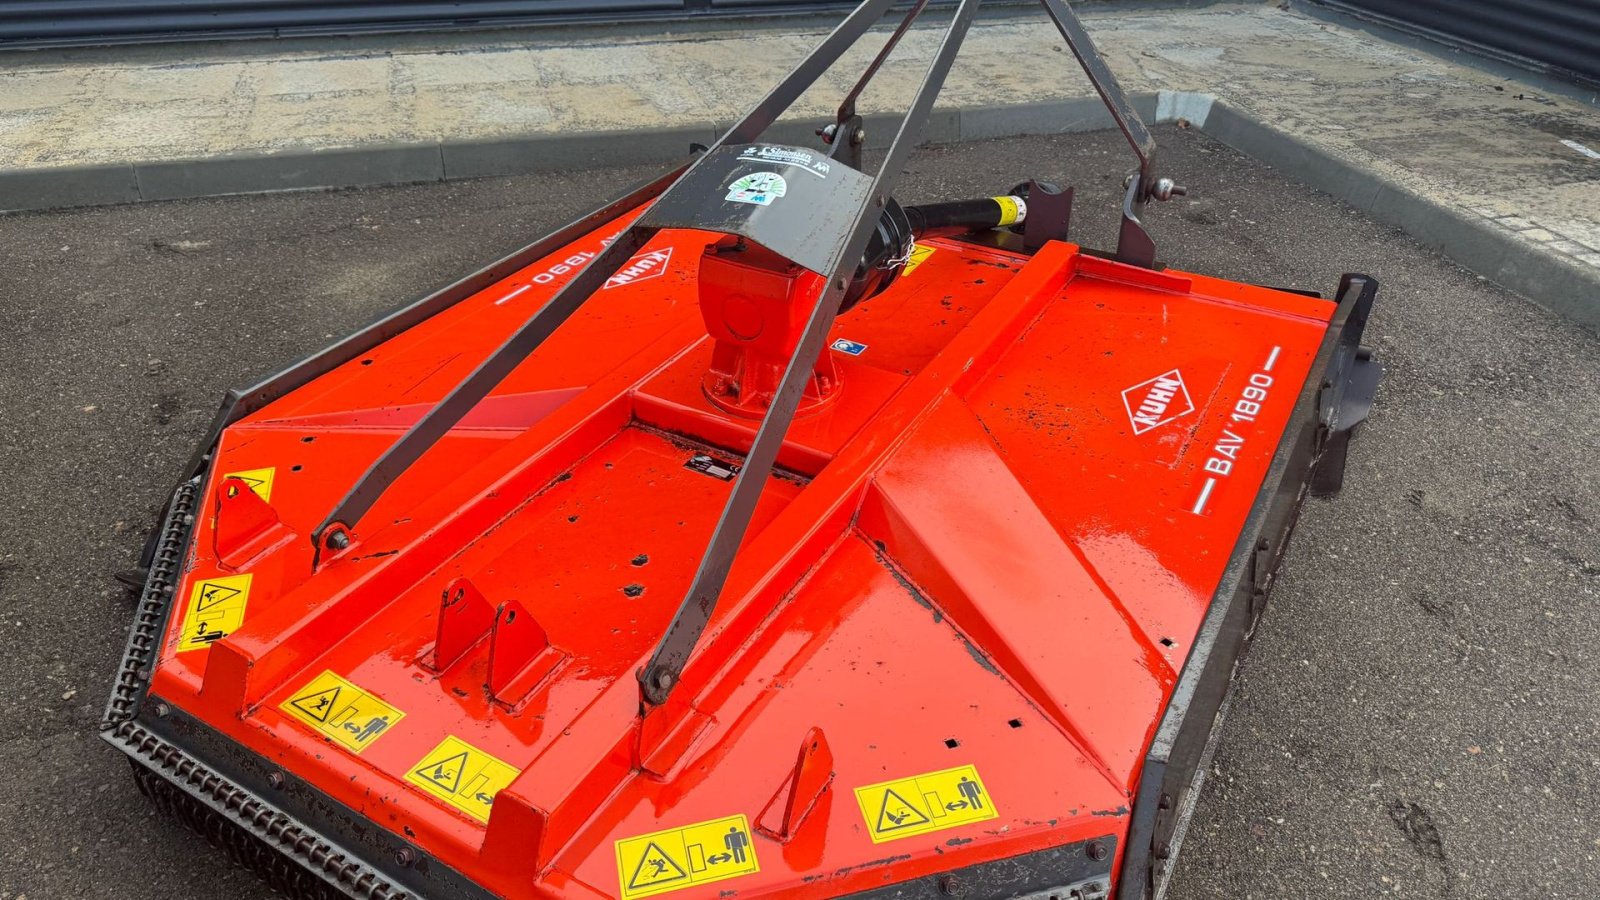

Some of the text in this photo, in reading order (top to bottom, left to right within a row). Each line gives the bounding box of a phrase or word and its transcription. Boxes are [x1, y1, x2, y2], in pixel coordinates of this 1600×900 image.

[532, 251, 595, 284] 1890
[609, 252, 668, 285] KUHN
[1133, 376, 1181, 426] KUHN
[1204, 373, 1274, 476] BAV 1890
